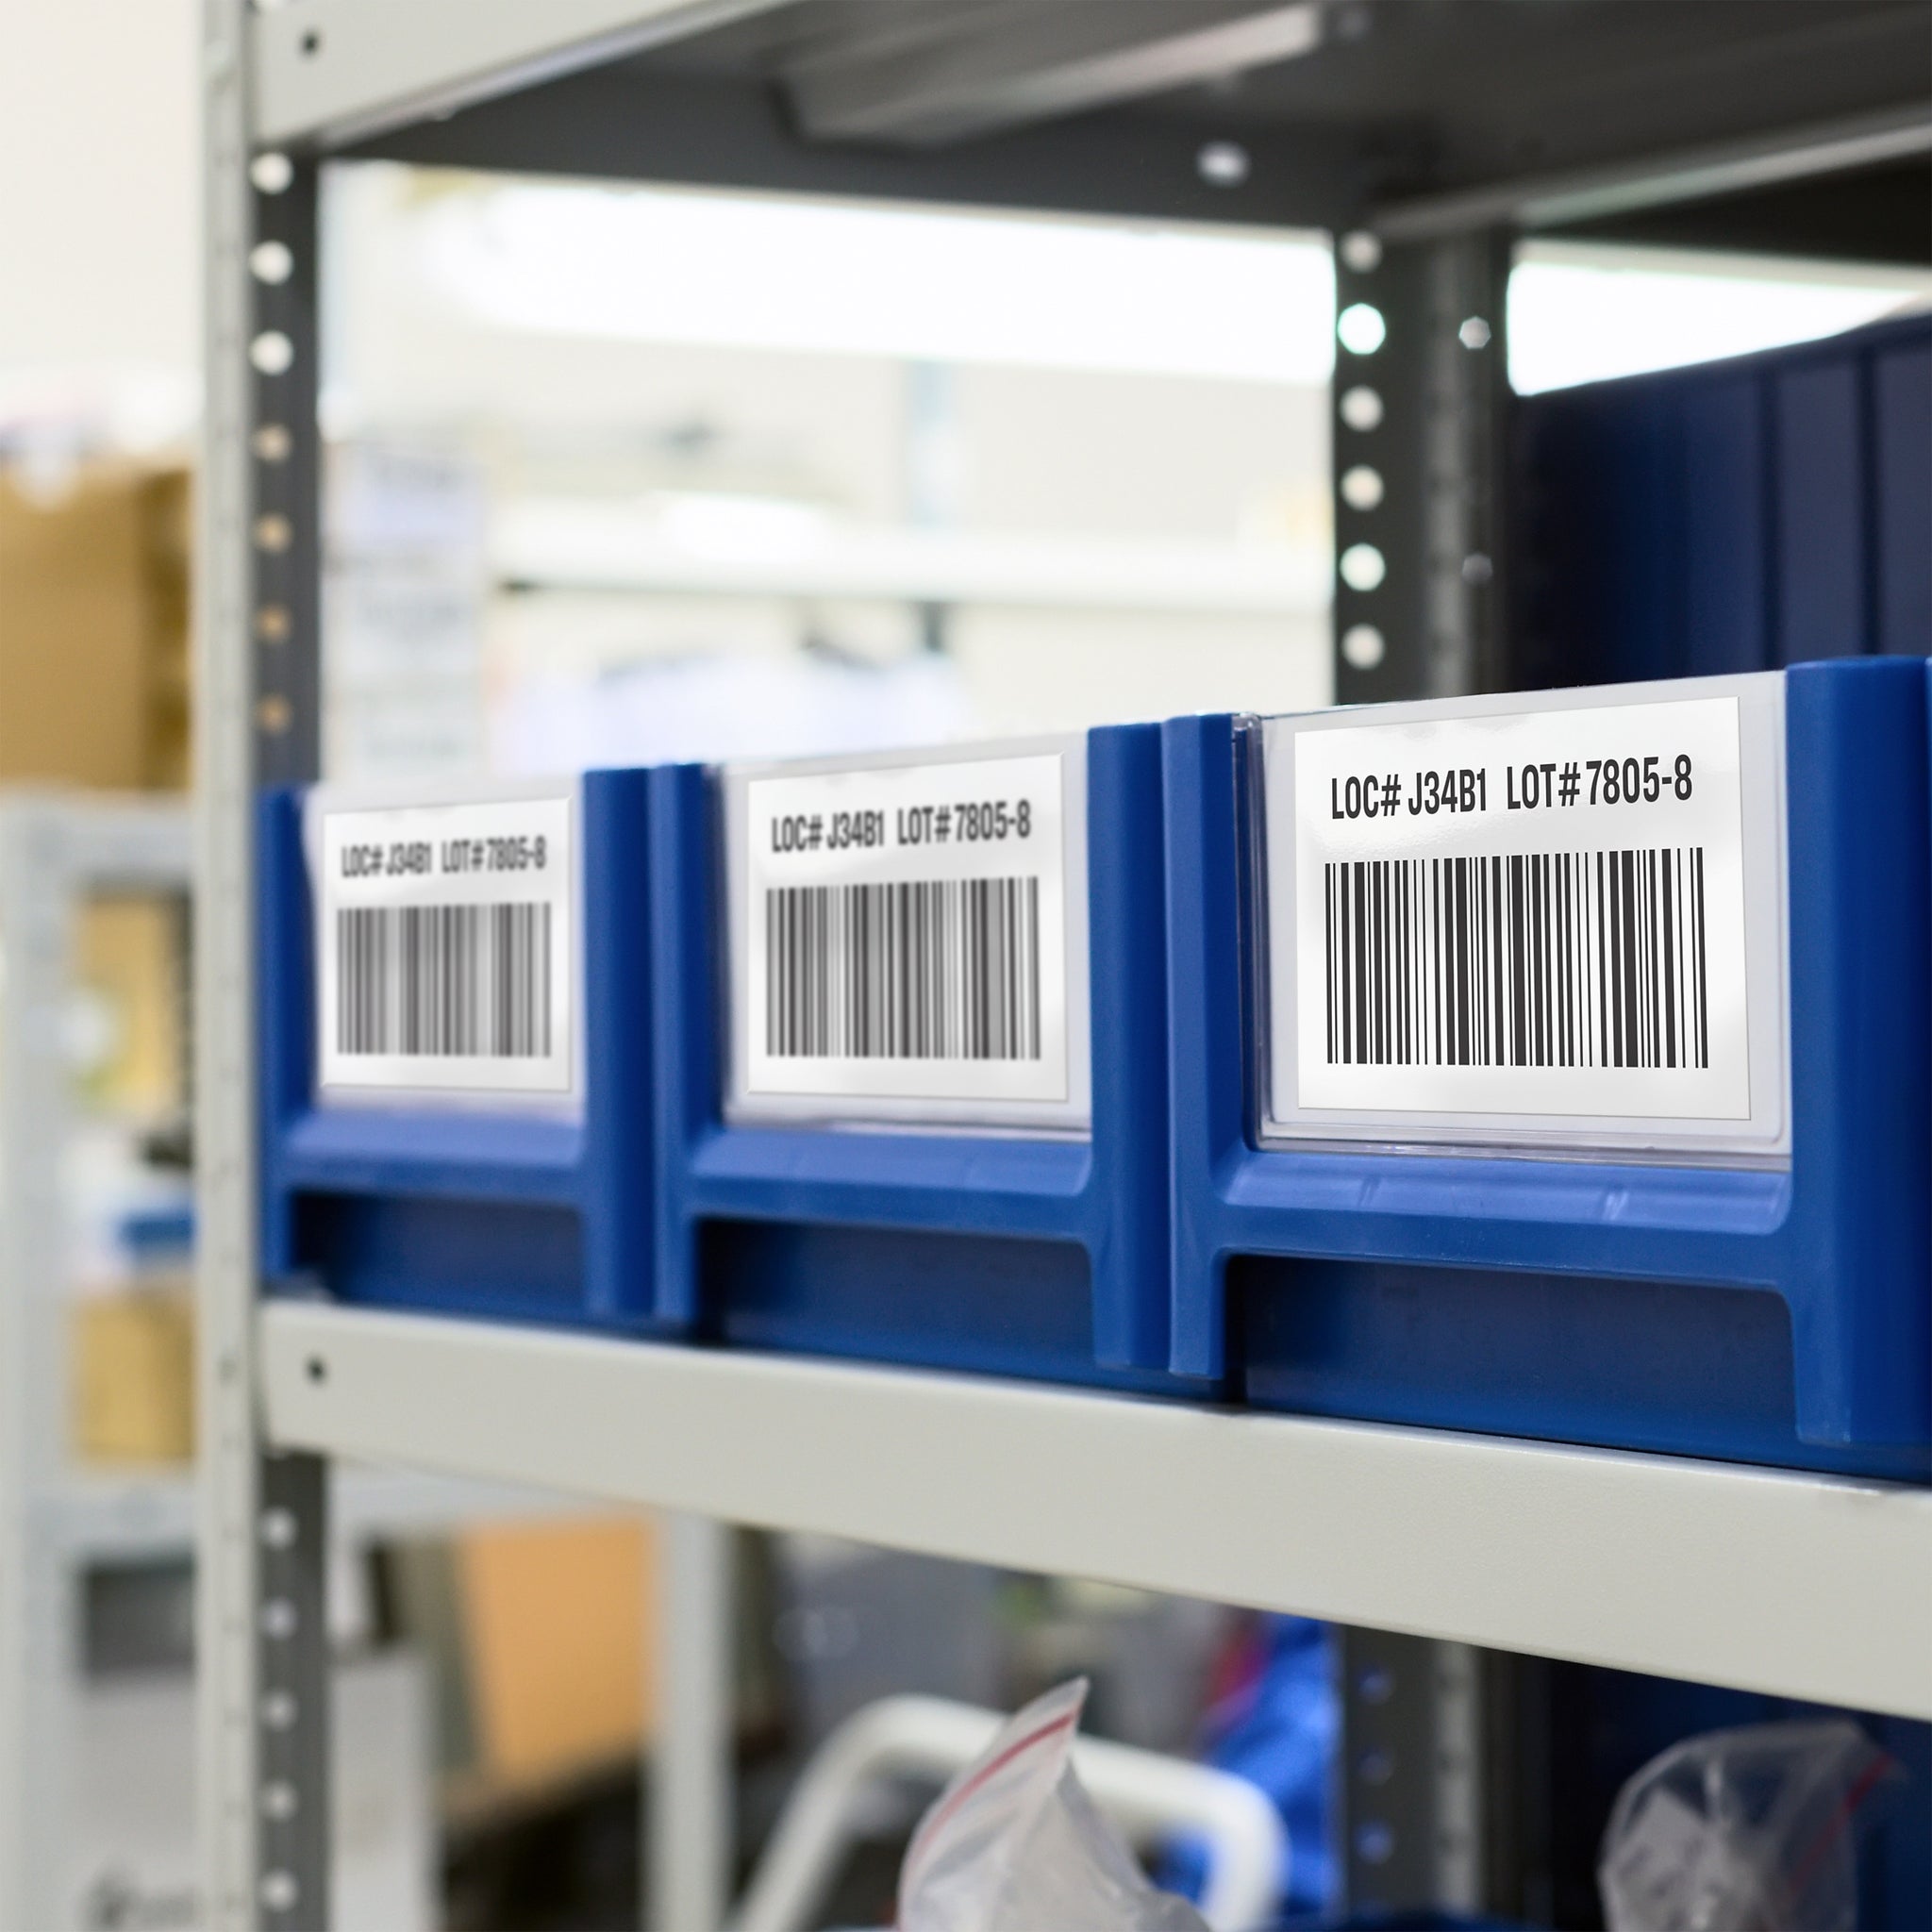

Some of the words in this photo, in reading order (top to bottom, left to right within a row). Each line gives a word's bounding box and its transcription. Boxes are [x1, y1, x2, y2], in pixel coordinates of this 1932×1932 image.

[1331, 774, 1402, 820] LOC#
[1407, 768, 1487, 816] J34B1
[1507, 761, 1581, 810] LOT#
[1586, 754, 1692, 806] 7805-8
[772, 814, 824, 854] LOC#
[826, 809, 885, 849] J34B1
[898, 805, 952, 846] LOT#
[955, 799, 1031, 842] 7805-8
